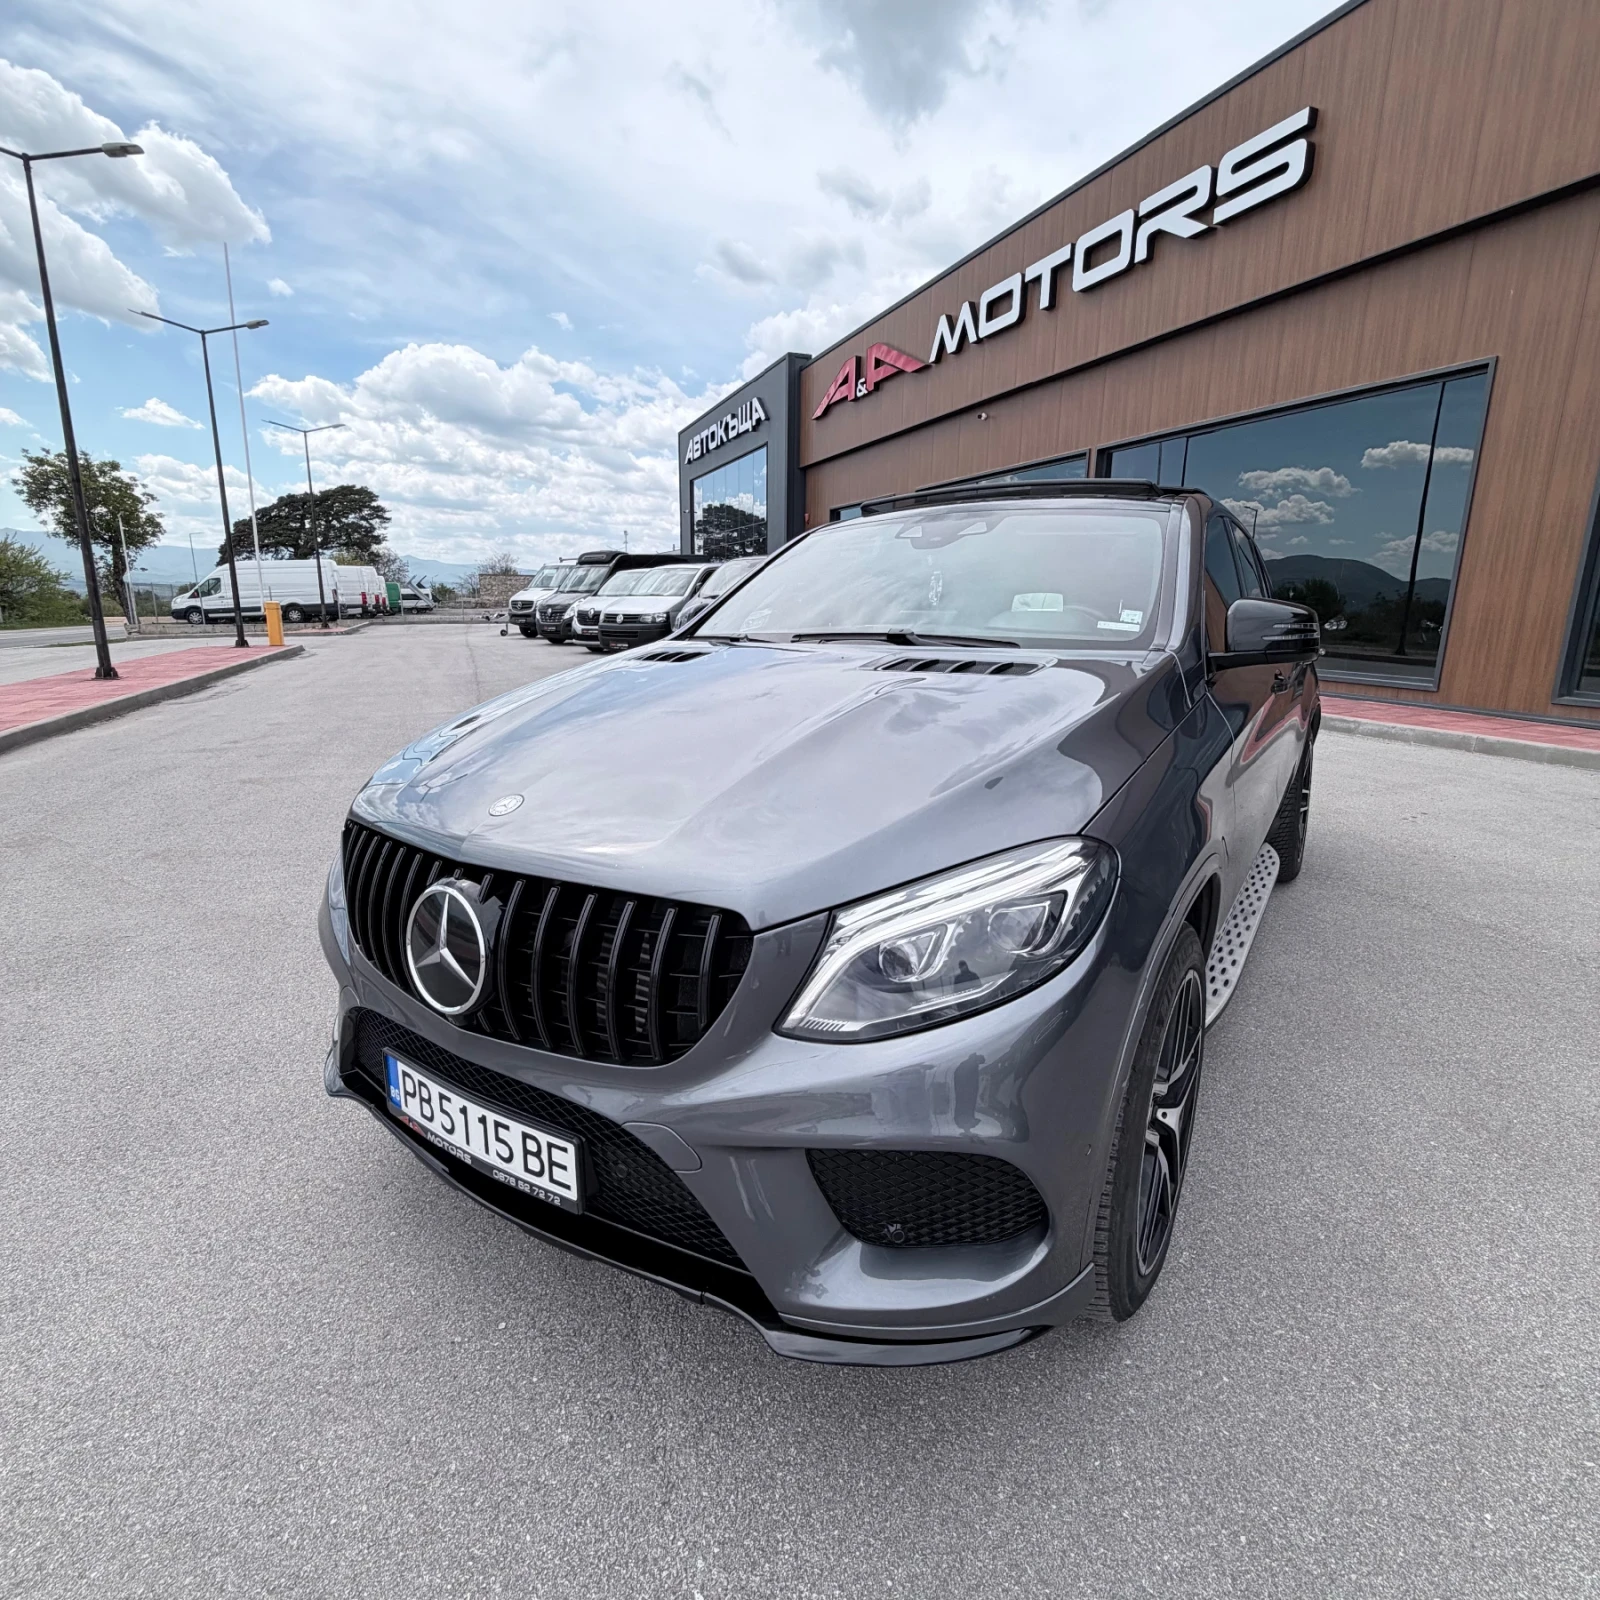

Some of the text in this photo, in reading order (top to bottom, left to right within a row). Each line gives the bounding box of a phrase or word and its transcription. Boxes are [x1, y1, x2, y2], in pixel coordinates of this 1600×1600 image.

[811, 106, 1317, 420] A&A MOTORS
[684, 397, 768, 465] АВТОКЪЩА
[389, 1085, 400, 1101] BG
[427, 1132, 472, 1165] MOTORS
[532, 1186, 546, 1200] 72
[547, 1193, 561, 1206] 72
